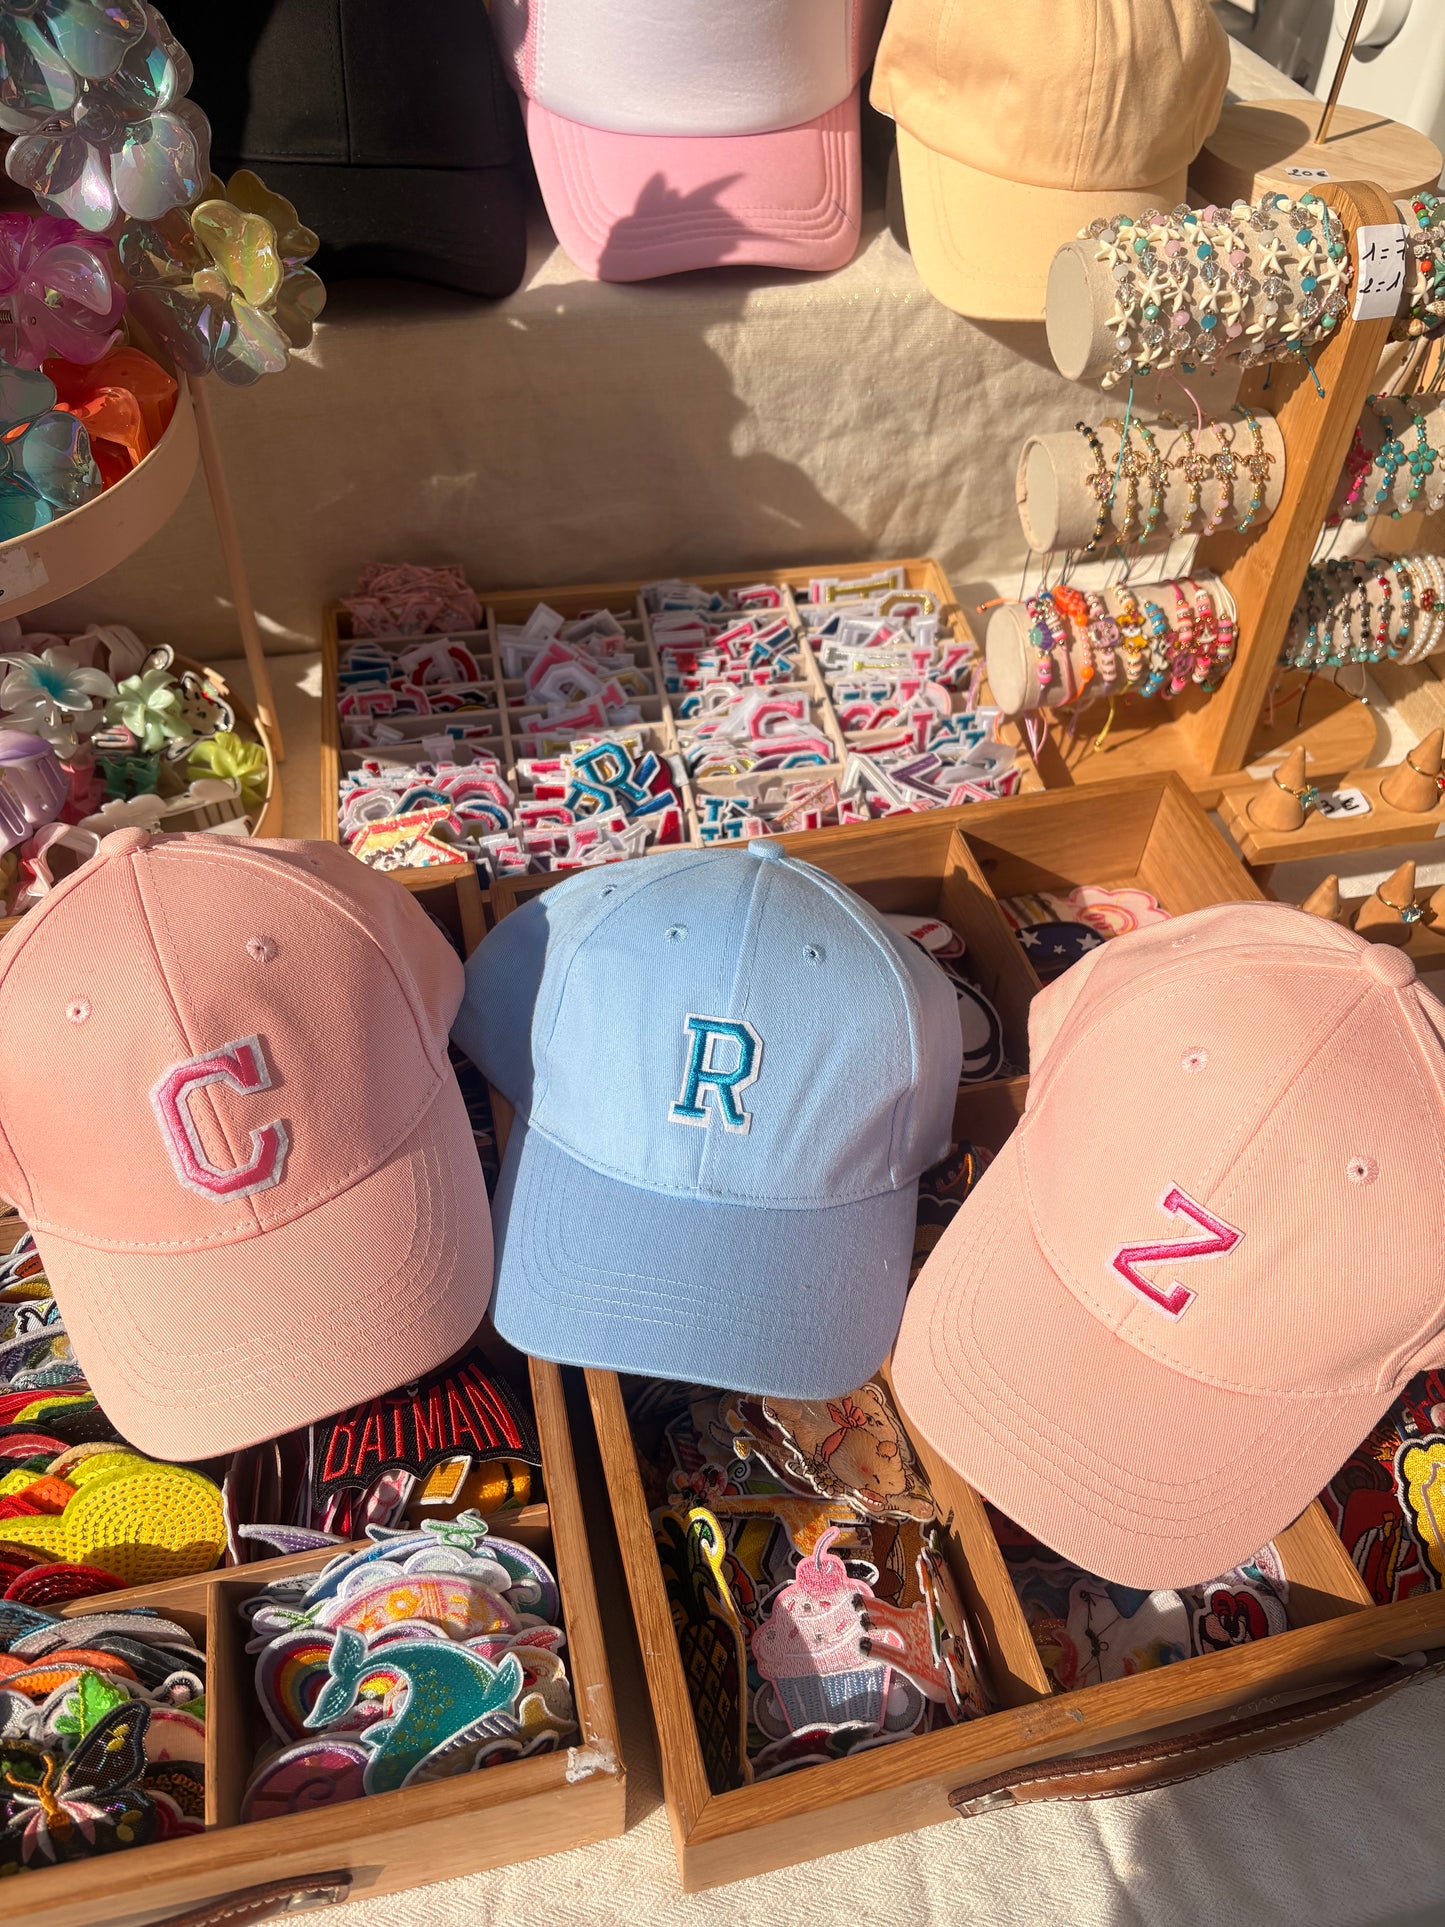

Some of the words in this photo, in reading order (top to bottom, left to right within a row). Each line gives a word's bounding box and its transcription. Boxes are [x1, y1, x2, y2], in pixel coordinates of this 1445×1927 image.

[152, 1038, 285, 1200] C
[670, 1014, 761, 1131] R
[323, 1363, 522, 1482] BATMAN
